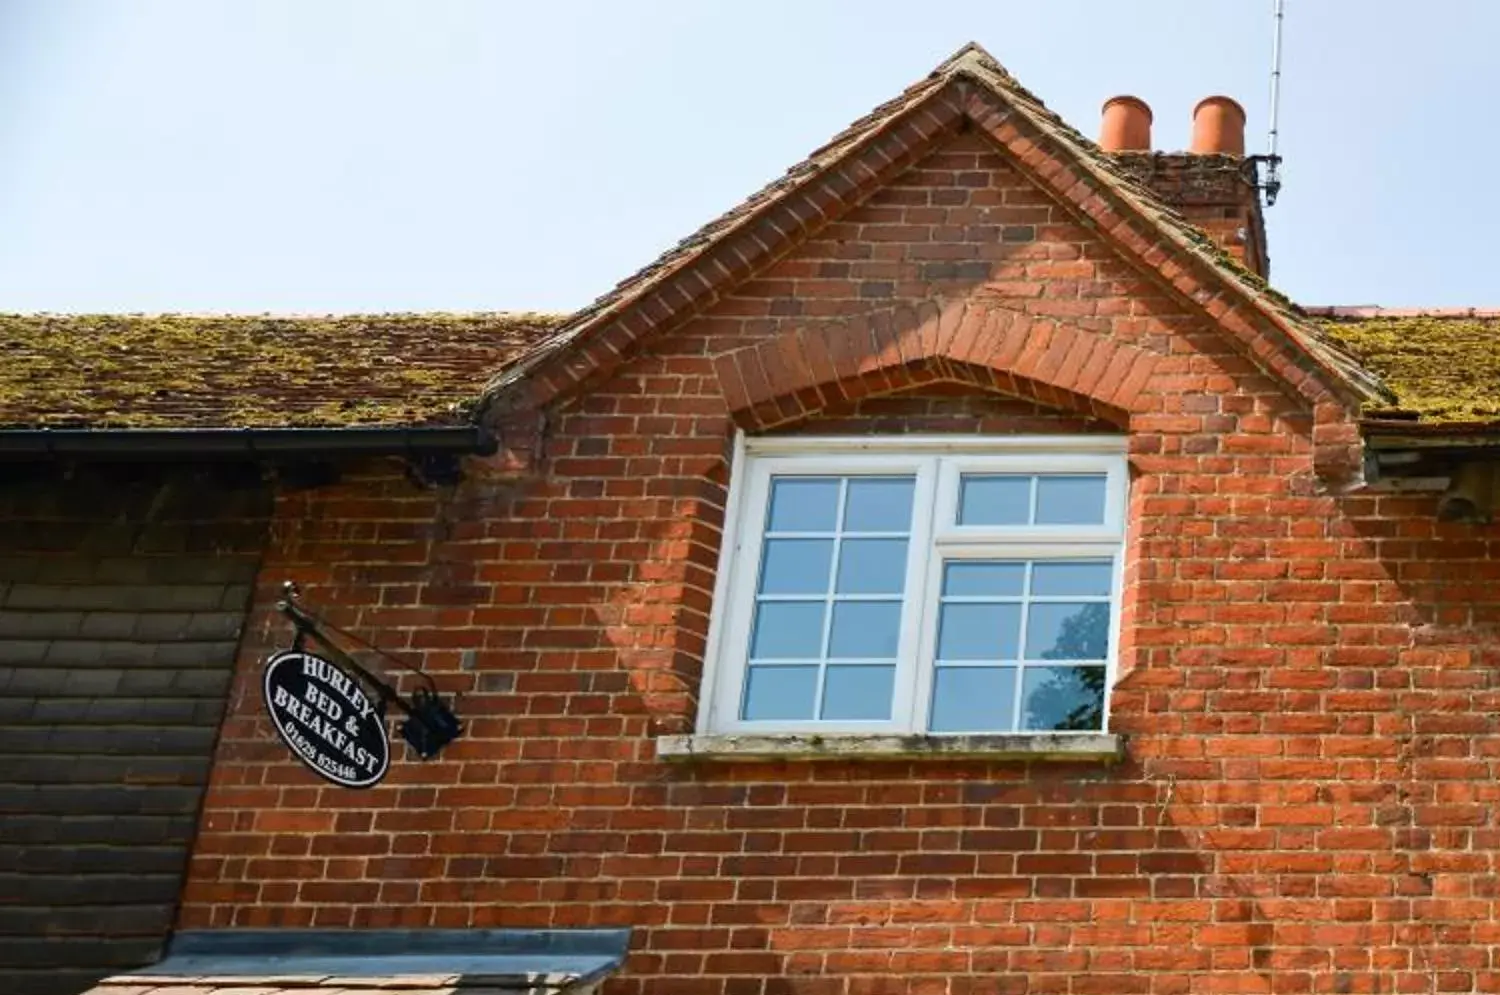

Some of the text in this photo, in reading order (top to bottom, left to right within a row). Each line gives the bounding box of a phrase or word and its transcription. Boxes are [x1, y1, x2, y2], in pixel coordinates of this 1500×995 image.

[303, 654, 374, 720] HURLEY
[305, 682, 360, 737] BED &
[274, 685, 378, 773] BREAKFAST
